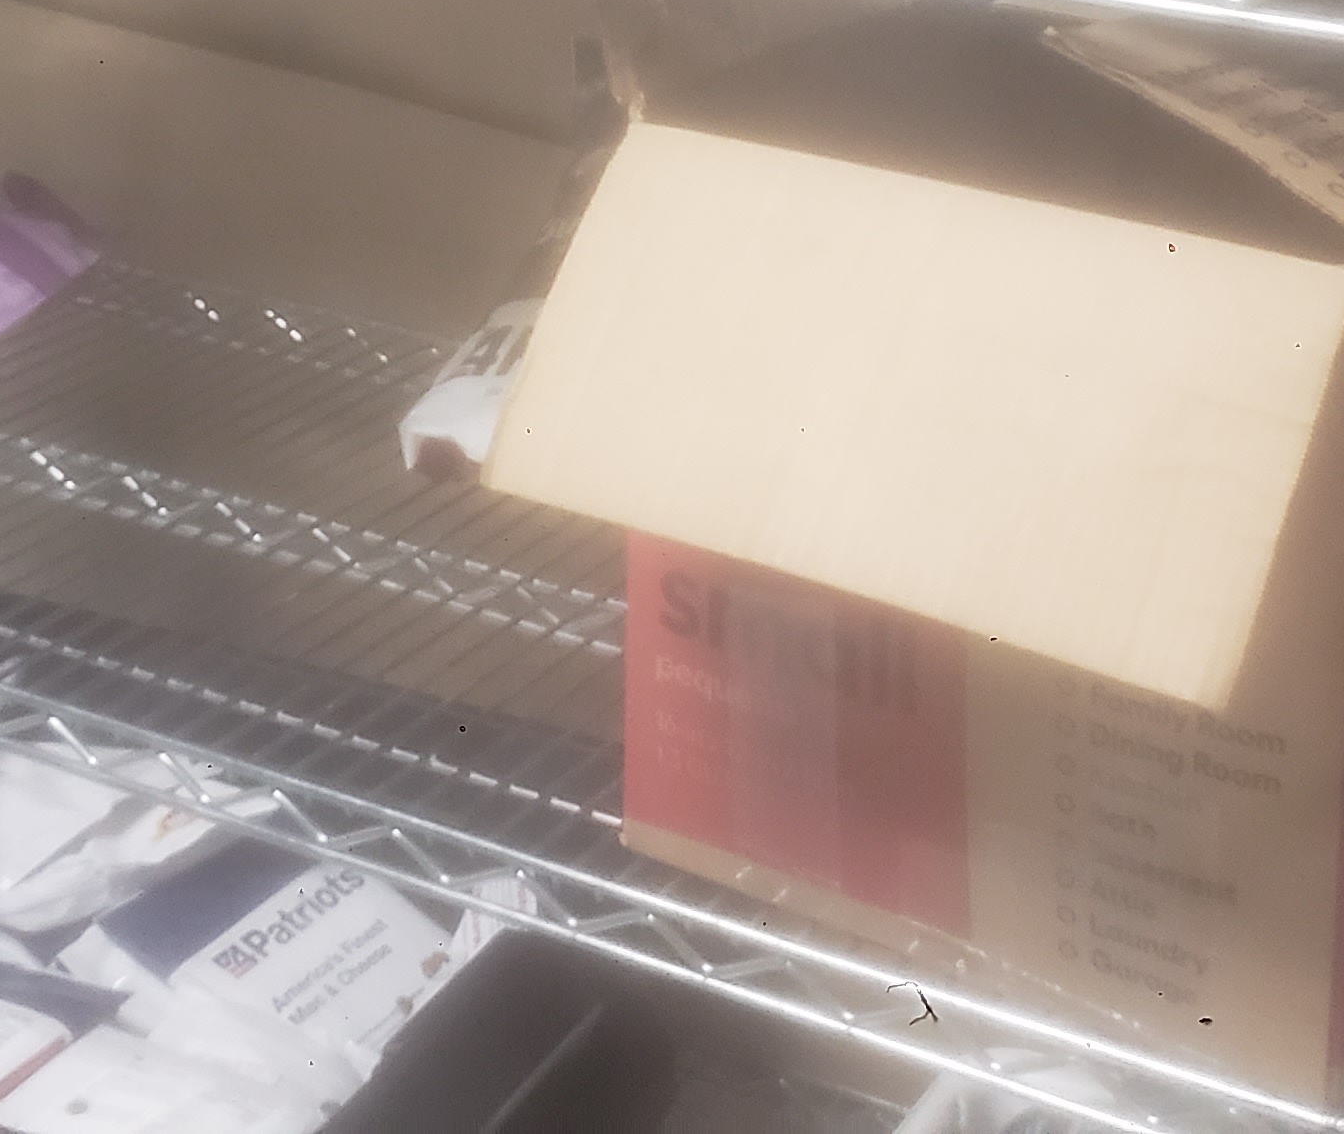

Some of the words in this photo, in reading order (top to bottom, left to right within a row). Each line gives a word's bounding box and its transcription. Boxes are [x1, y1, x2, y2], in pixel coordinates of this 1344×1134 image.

[1090, 682, 1189, 735] Family
[1196, 711, 1289, 756] Room
[1089, 721, 1185, 777] Dining
[1192, 750, 1284, 796] Room
[1089, 913, 1210, 976] Laundry
